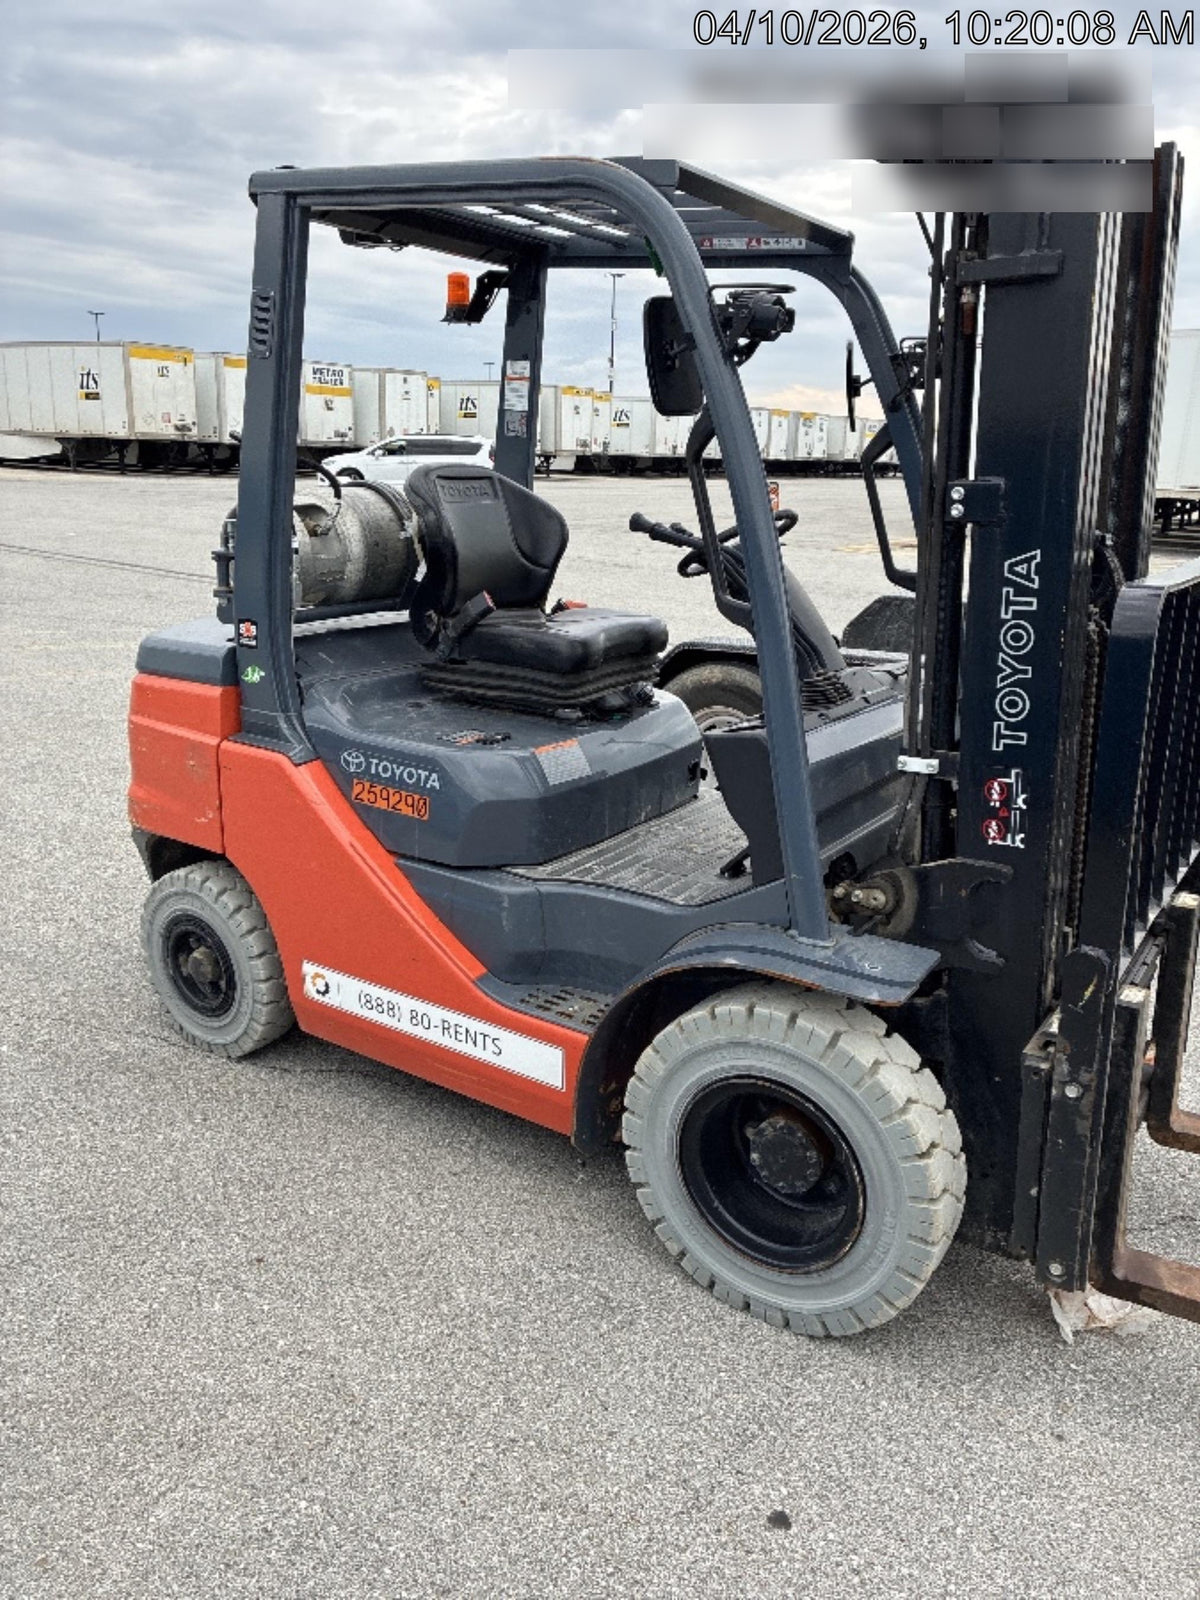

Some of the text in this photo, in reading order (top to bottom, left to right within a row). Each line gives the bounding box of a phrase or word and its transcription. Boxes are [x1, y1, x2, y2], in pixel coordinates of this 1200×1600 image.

[79, 365, 99, 390] its
[440, 484, 490, 498] TOYOTA
[991, 549, 1042, 751] TOYOTA
[368, 758, 440, 790] TOYOTA
[354, 781, 428, 819] 259290
[358, 989, 503, 1057] (888) 80-RENTS
